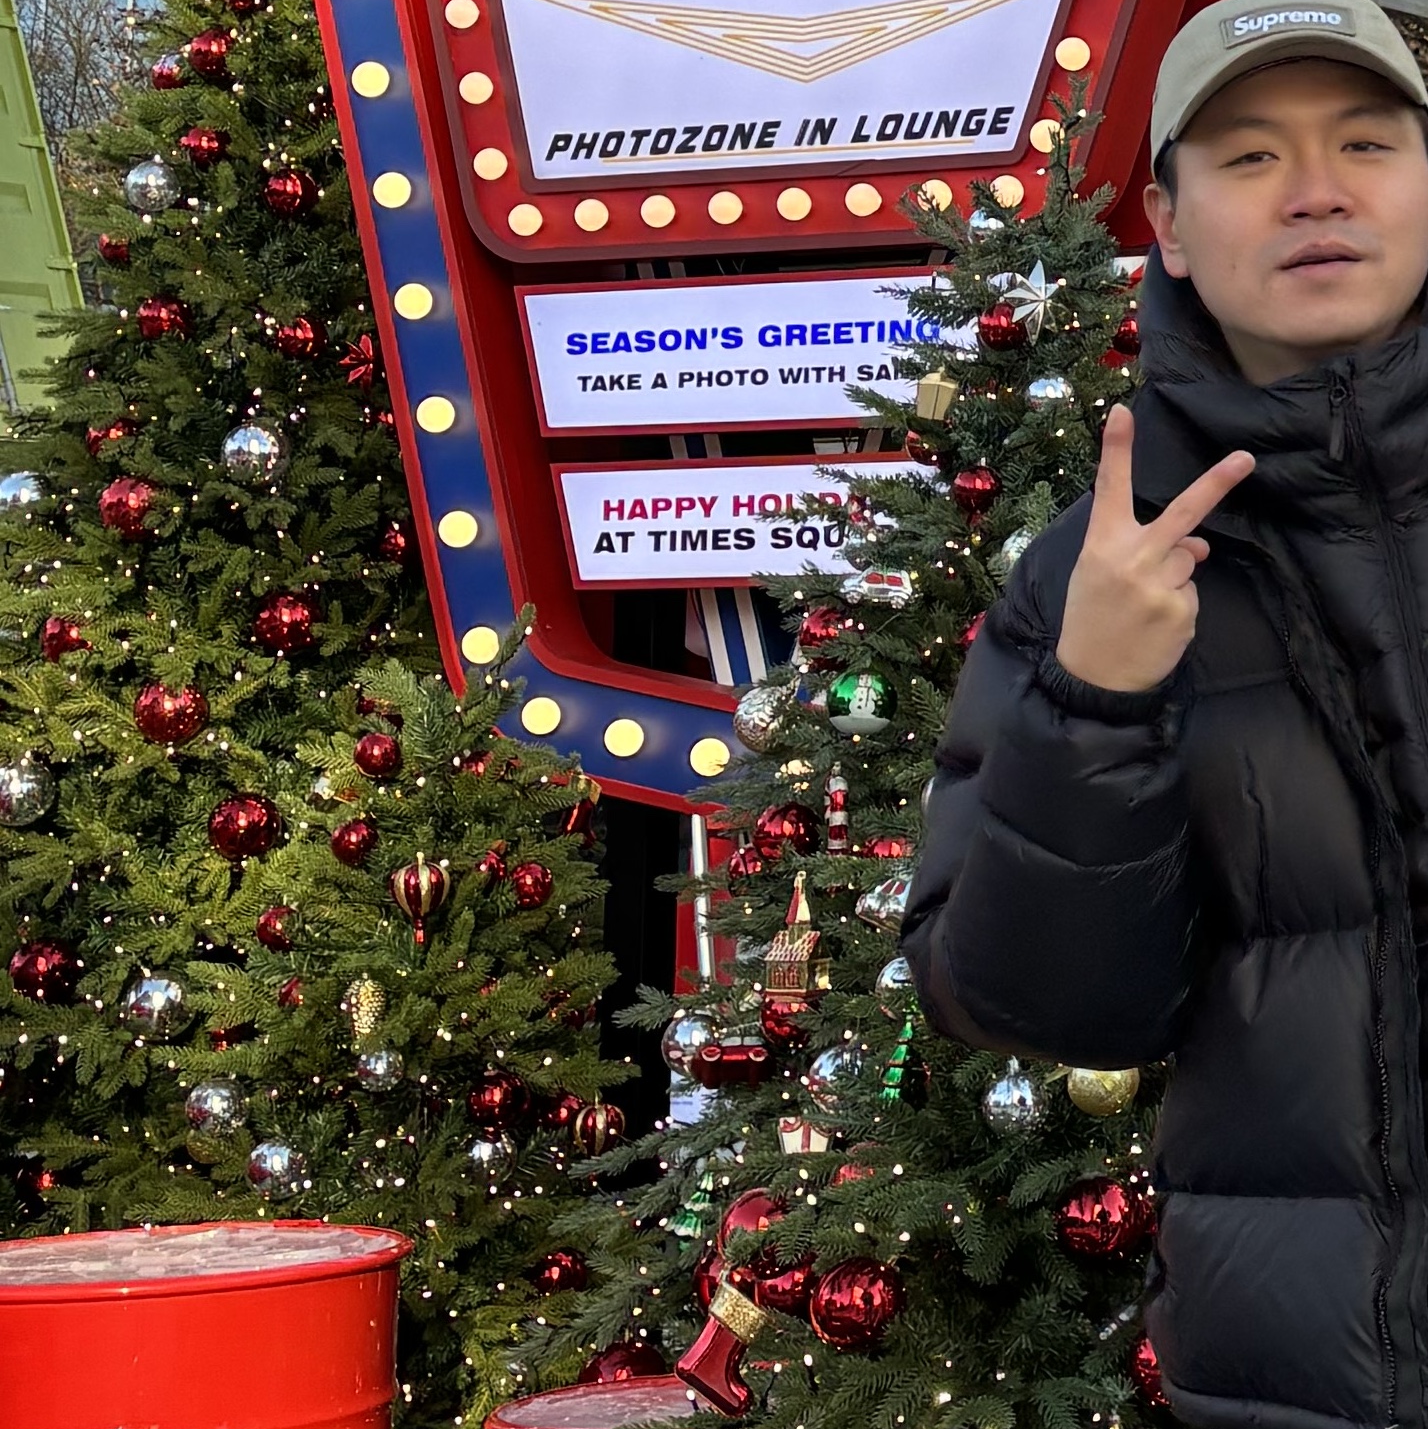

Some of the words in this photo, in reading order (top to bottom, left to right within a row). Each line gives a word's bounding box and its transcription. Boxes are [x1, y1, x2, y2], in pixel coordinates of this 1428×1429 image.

[1233, 10, 1342, 37] Supreme
[545, 120, 782, 162] PHOTOZONE
[794, 116, 838, 147] IN
[850, 106, 1016, 144] LOUNGE
[566, 325, 744, 356] SEASON'S
[577, 374, 642, 393] TAKE
[651, 372, 668, 390] A
[678, 368, 769, 389] PHOTO
[779, 365, 846, 385] WITH
[603, 495, 719, 521] HAPPY
[593, 530, 636, 554] AT
[648, 527, 756, 553] TIMES
